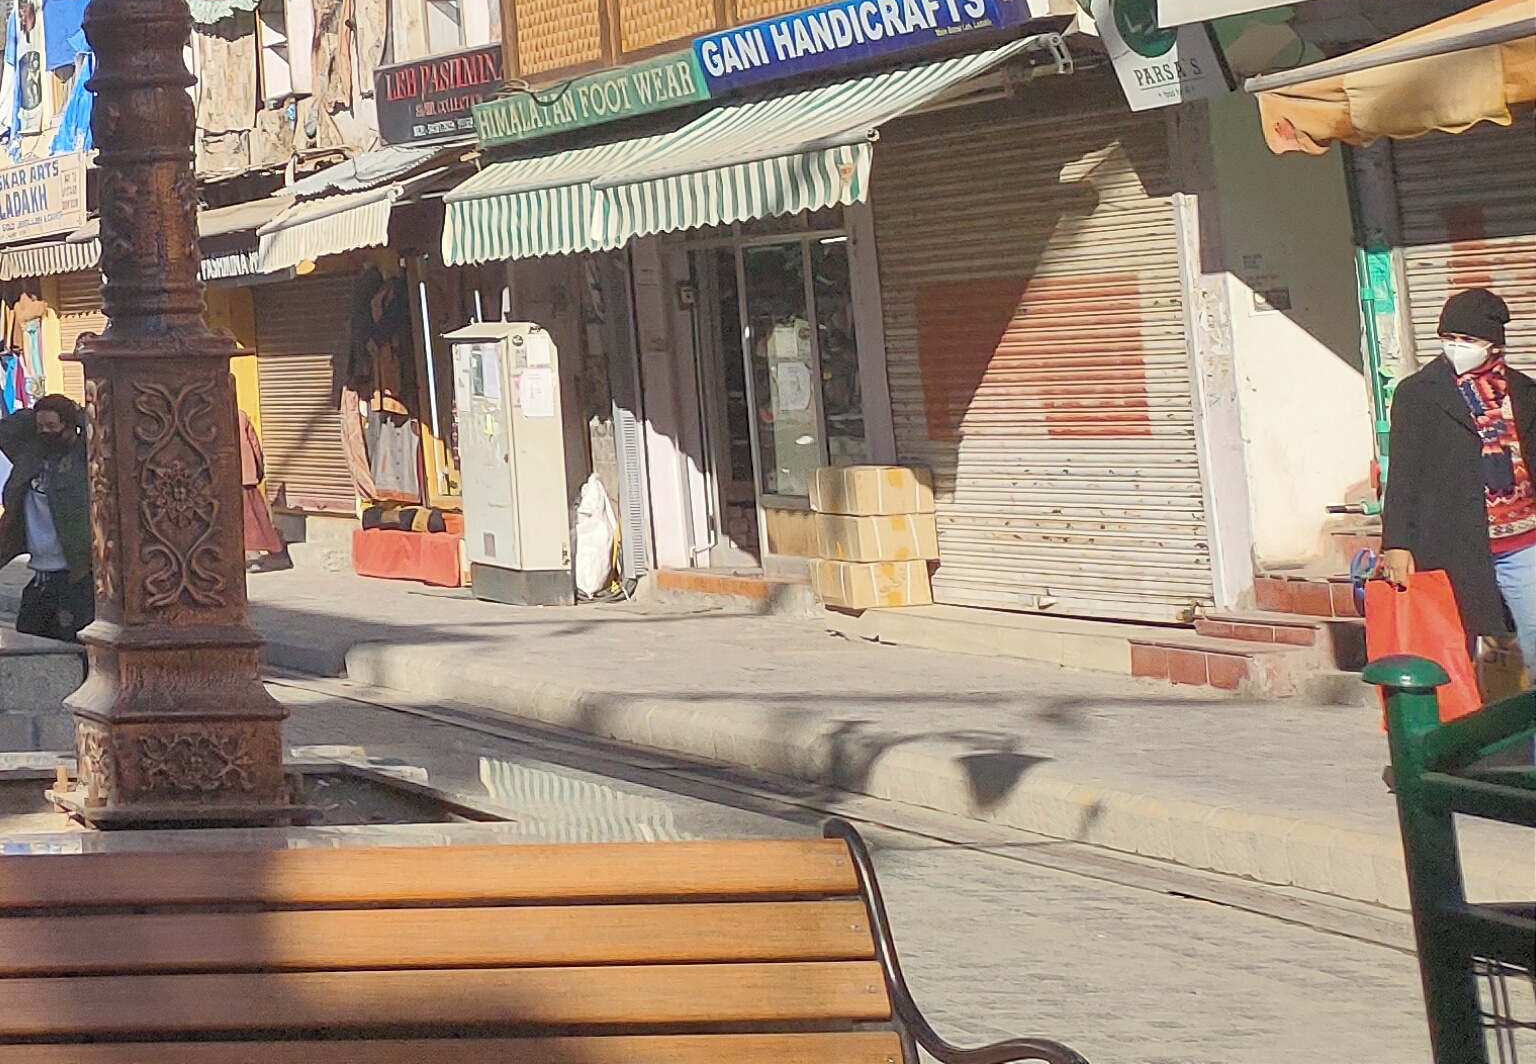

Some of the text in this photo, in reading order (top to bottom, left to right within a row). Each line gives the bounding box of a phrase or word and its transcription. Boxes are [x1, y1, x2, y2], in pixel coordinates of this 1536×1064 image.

[701, 34, 771, 78] GANI
[1133, 56, 1203, 87] PARSA'S
[477, 88, 577, 140] HIMALAYAN
[577, 72, 629, 118] FOOT
[632, 60, 698, 105] WEAR
[29, 159, 60, 184] ARTS
